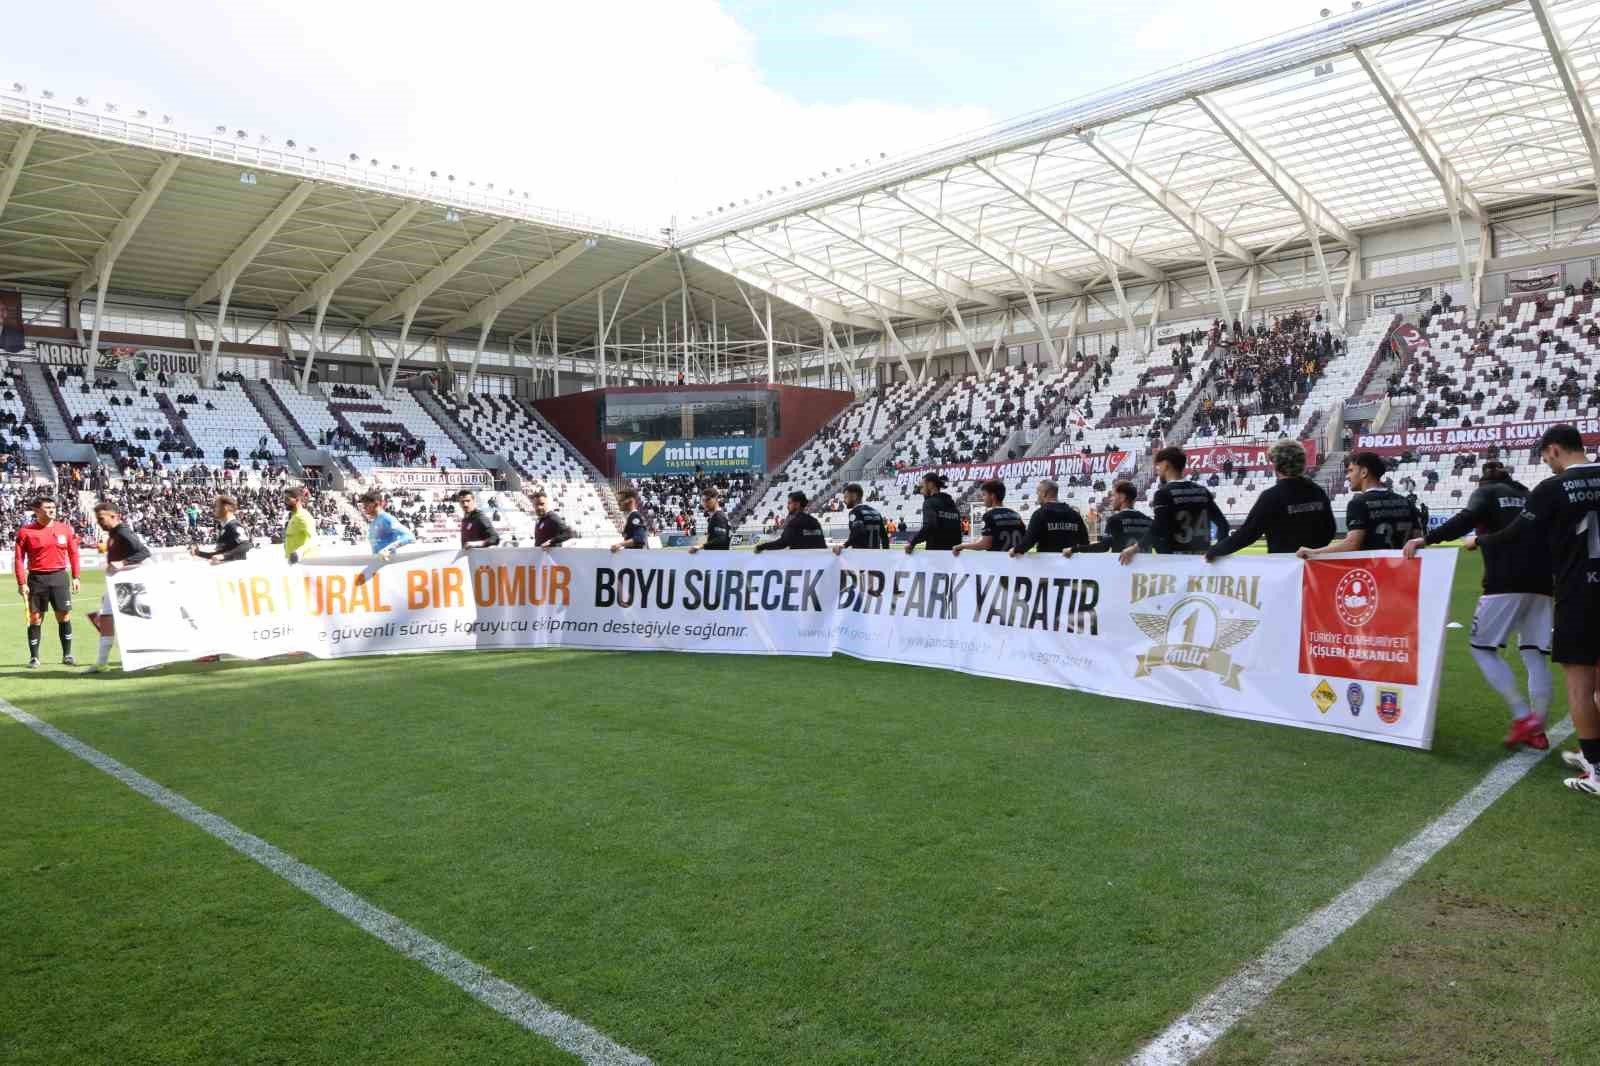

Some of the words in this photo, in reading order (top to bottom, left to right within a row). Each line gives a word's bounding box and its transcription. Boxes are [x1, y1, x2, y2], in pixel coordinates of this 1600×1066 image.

[665, 442, 749, 460] minerra
[1358, 434, 1402, 448] FORZA
[1407, 431, 1442, 445] KALE
[595, 567, 676, 610] BOYU
[889, 571, 970, 621] FARK
[972, 573, 1100, 636] YARATIR
[1186, 575, 1262, 610] KURAL
[331, 621, 396, 643] güvenli
[399, 621, 447, 636] sürüş
[454, 618, 527, 636] koruyucu
[532, 614, 599, 634] ekipman
[602, 620, 680, 638] desteğiyle
[1183, 608, 1200, 644] 1
[1308, 632, 1343, 645] TÜRKİYE
[1309, 645, 1346, 659] İÇİŞLERİ
[1348, 647, 1409, 663] BAKANLIĞI
